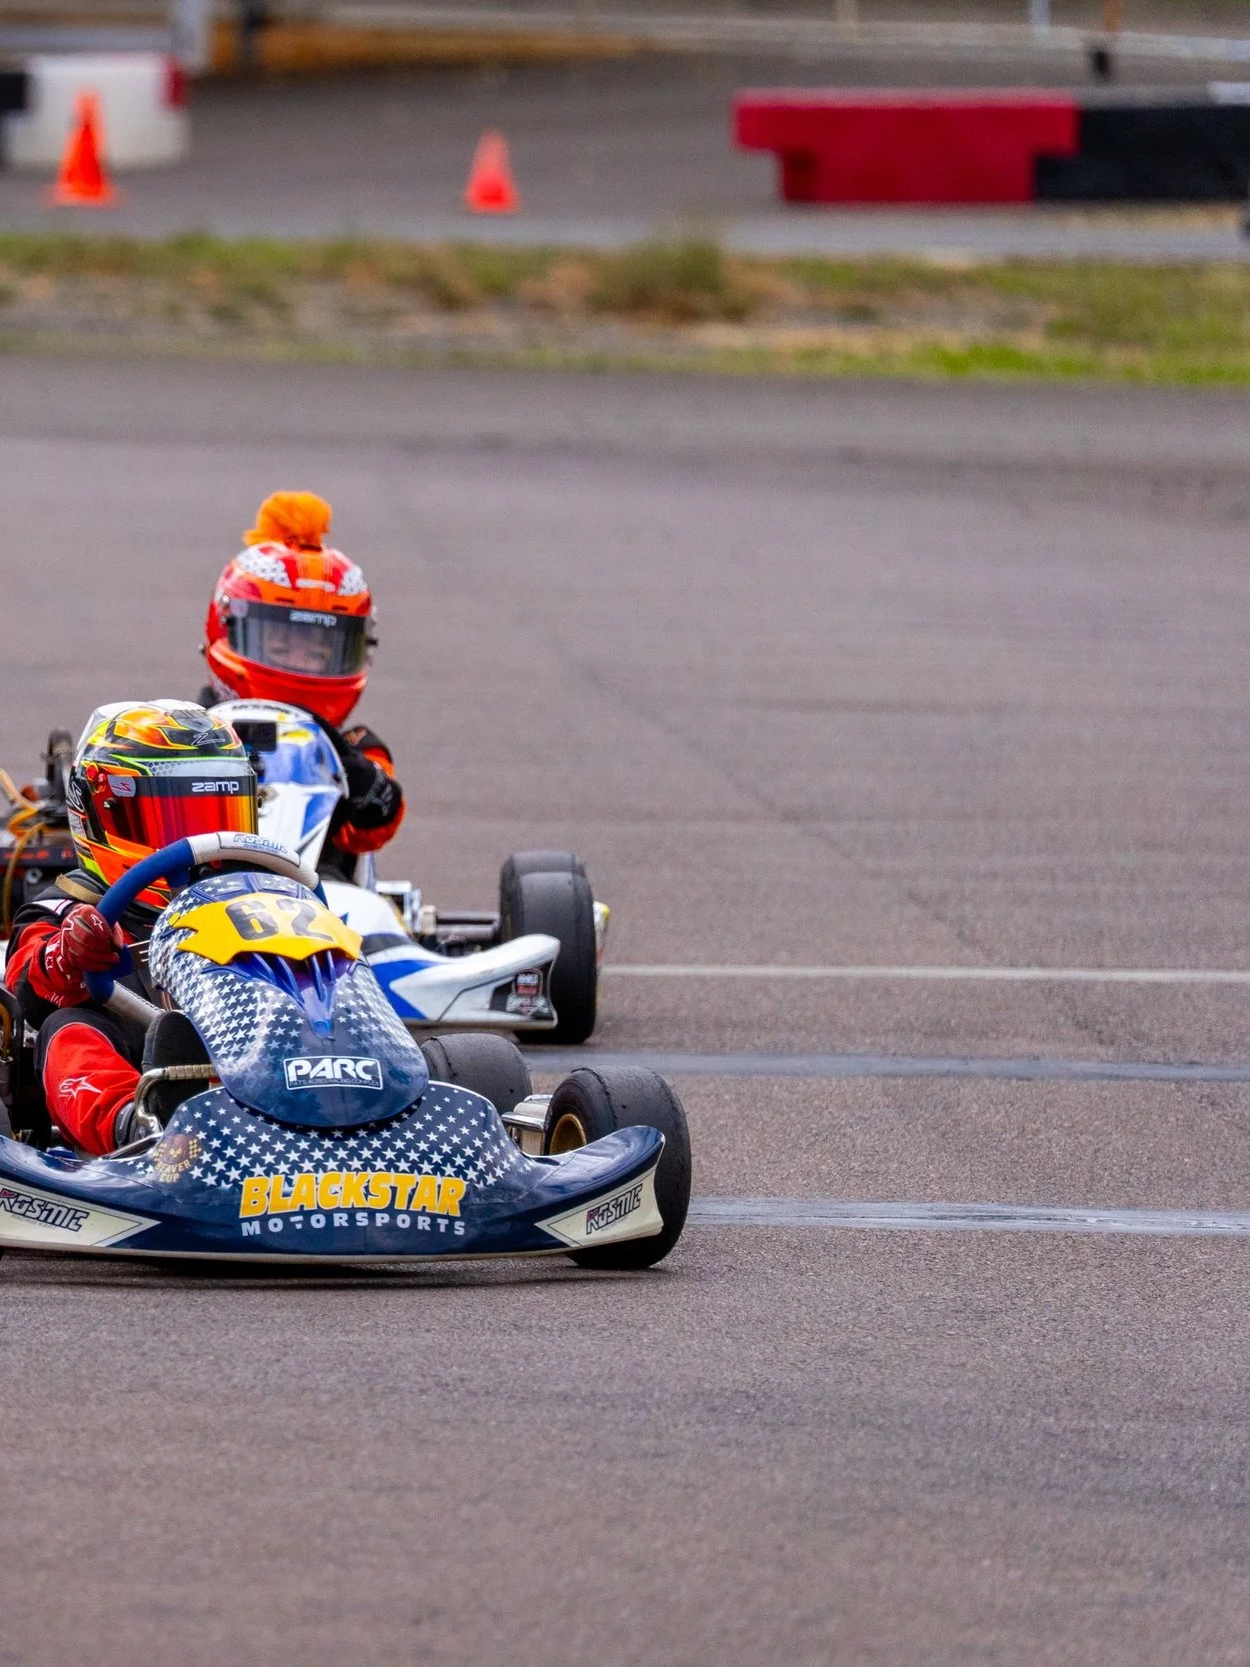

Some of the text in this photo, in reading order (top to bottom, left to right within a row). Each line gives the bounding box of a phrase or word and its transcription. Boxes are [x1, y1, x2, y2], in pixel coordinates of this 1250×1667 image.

[191, 781, 239, 794] zamp
[225, 898, 334, 942] 62
[288, 1058, 377, 1082] PARC
[155, 1160, 191, 1174] BEAVER
[159, 1173, 180, 1182] CUP
[239, 1171, 467, 1218] BLACKSTAR
[586, 1182, 643, 1235] KOSMIC
[241, 1212, 465, 1237] MOTORSPORTS
